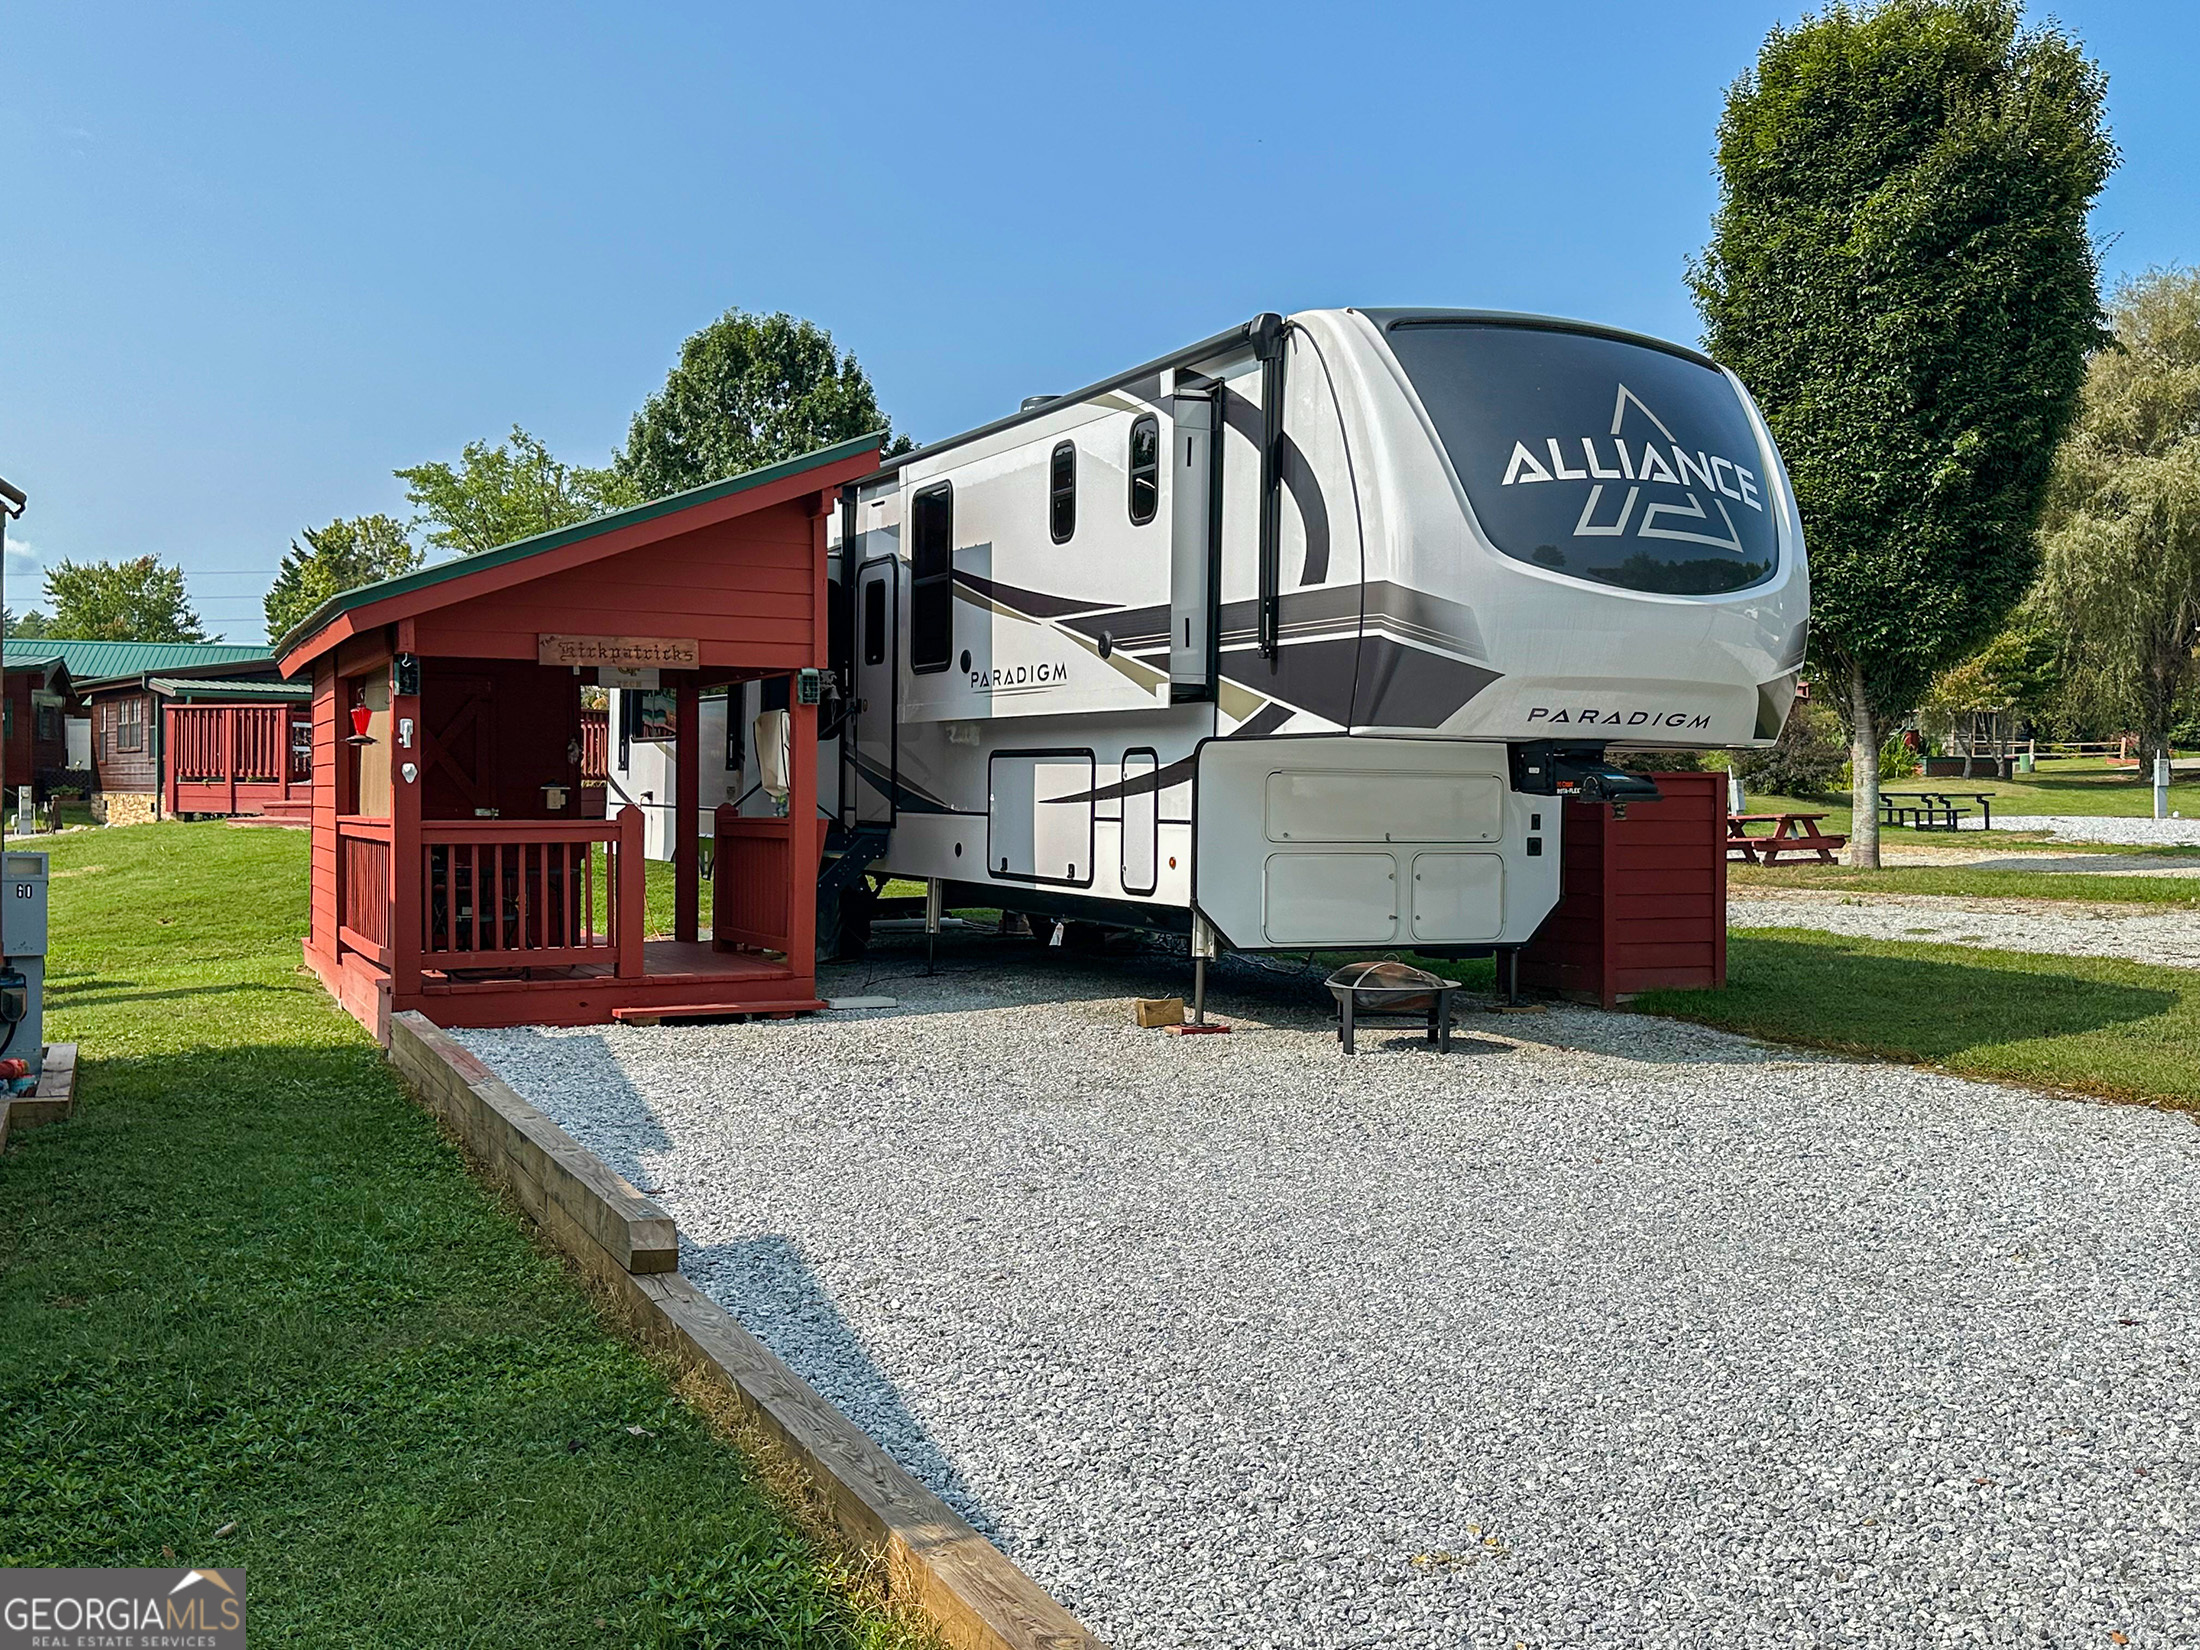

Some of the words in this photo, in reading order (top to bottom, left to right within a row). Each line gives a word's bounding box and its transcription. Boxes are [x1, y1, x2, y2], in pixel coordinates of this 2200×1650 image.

[1501, 437, 1762, 512] ALLIANCE
[558, 641, 693, 664] Kirkpatricks
[971, 662, 1067, 688] PARADIGM
[1527, 707, 1711, 729] PARADIGM
[16, 883, 32, 899] 60
